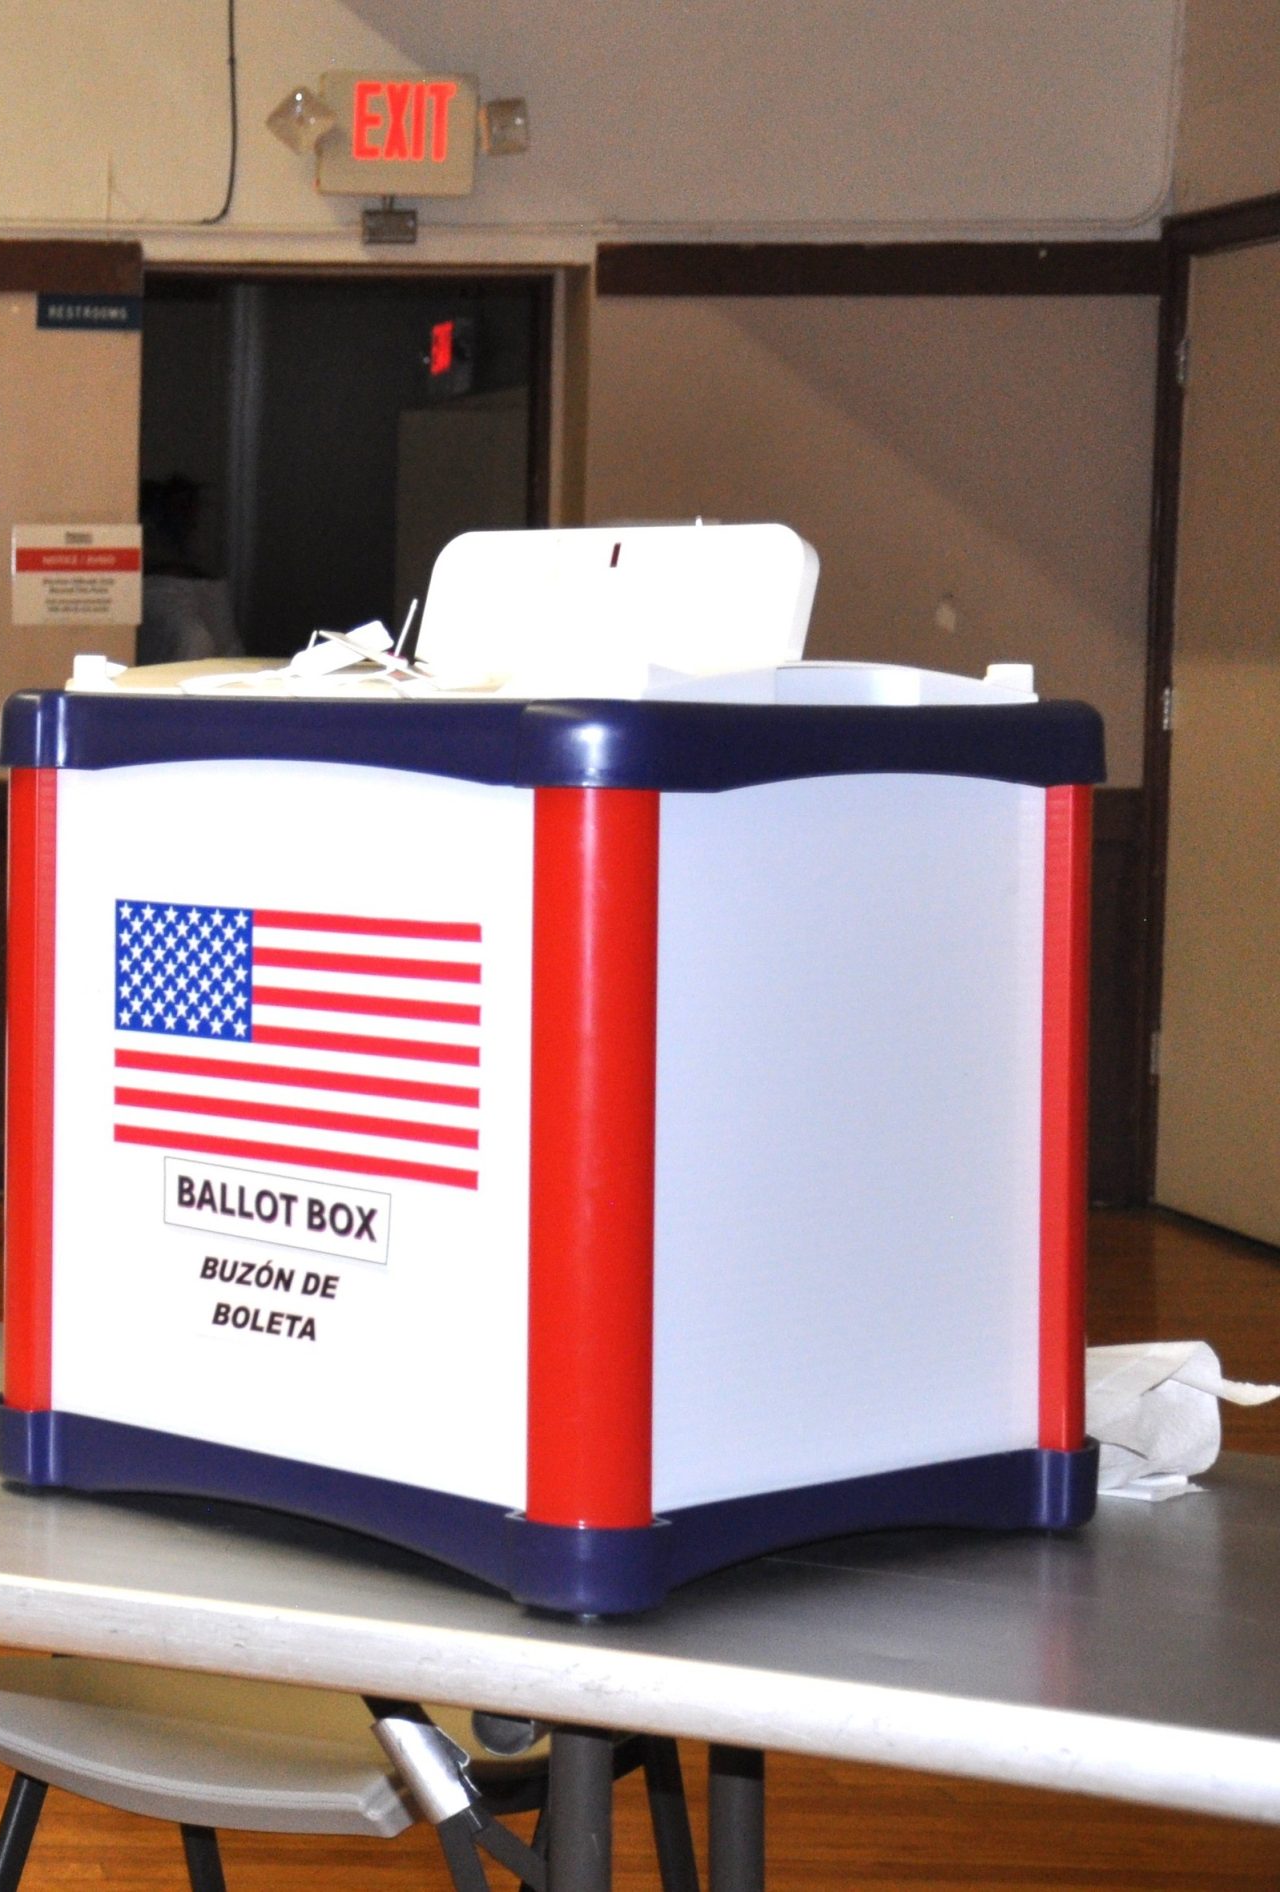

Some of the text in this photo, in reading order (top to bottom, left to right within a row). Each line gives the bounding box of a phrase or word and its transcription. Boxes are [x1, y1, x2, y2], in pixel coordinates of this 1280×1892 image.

[352, 80, 458, 162] EXIT
[47, 304, 127, 320] RESTROOMS
[176, 1174, 378, 1243] BALLOT BOX
[199, 1256, 340, 1300] BUZÓN DE
[211, 1302, 317, 1342] BOLETA
